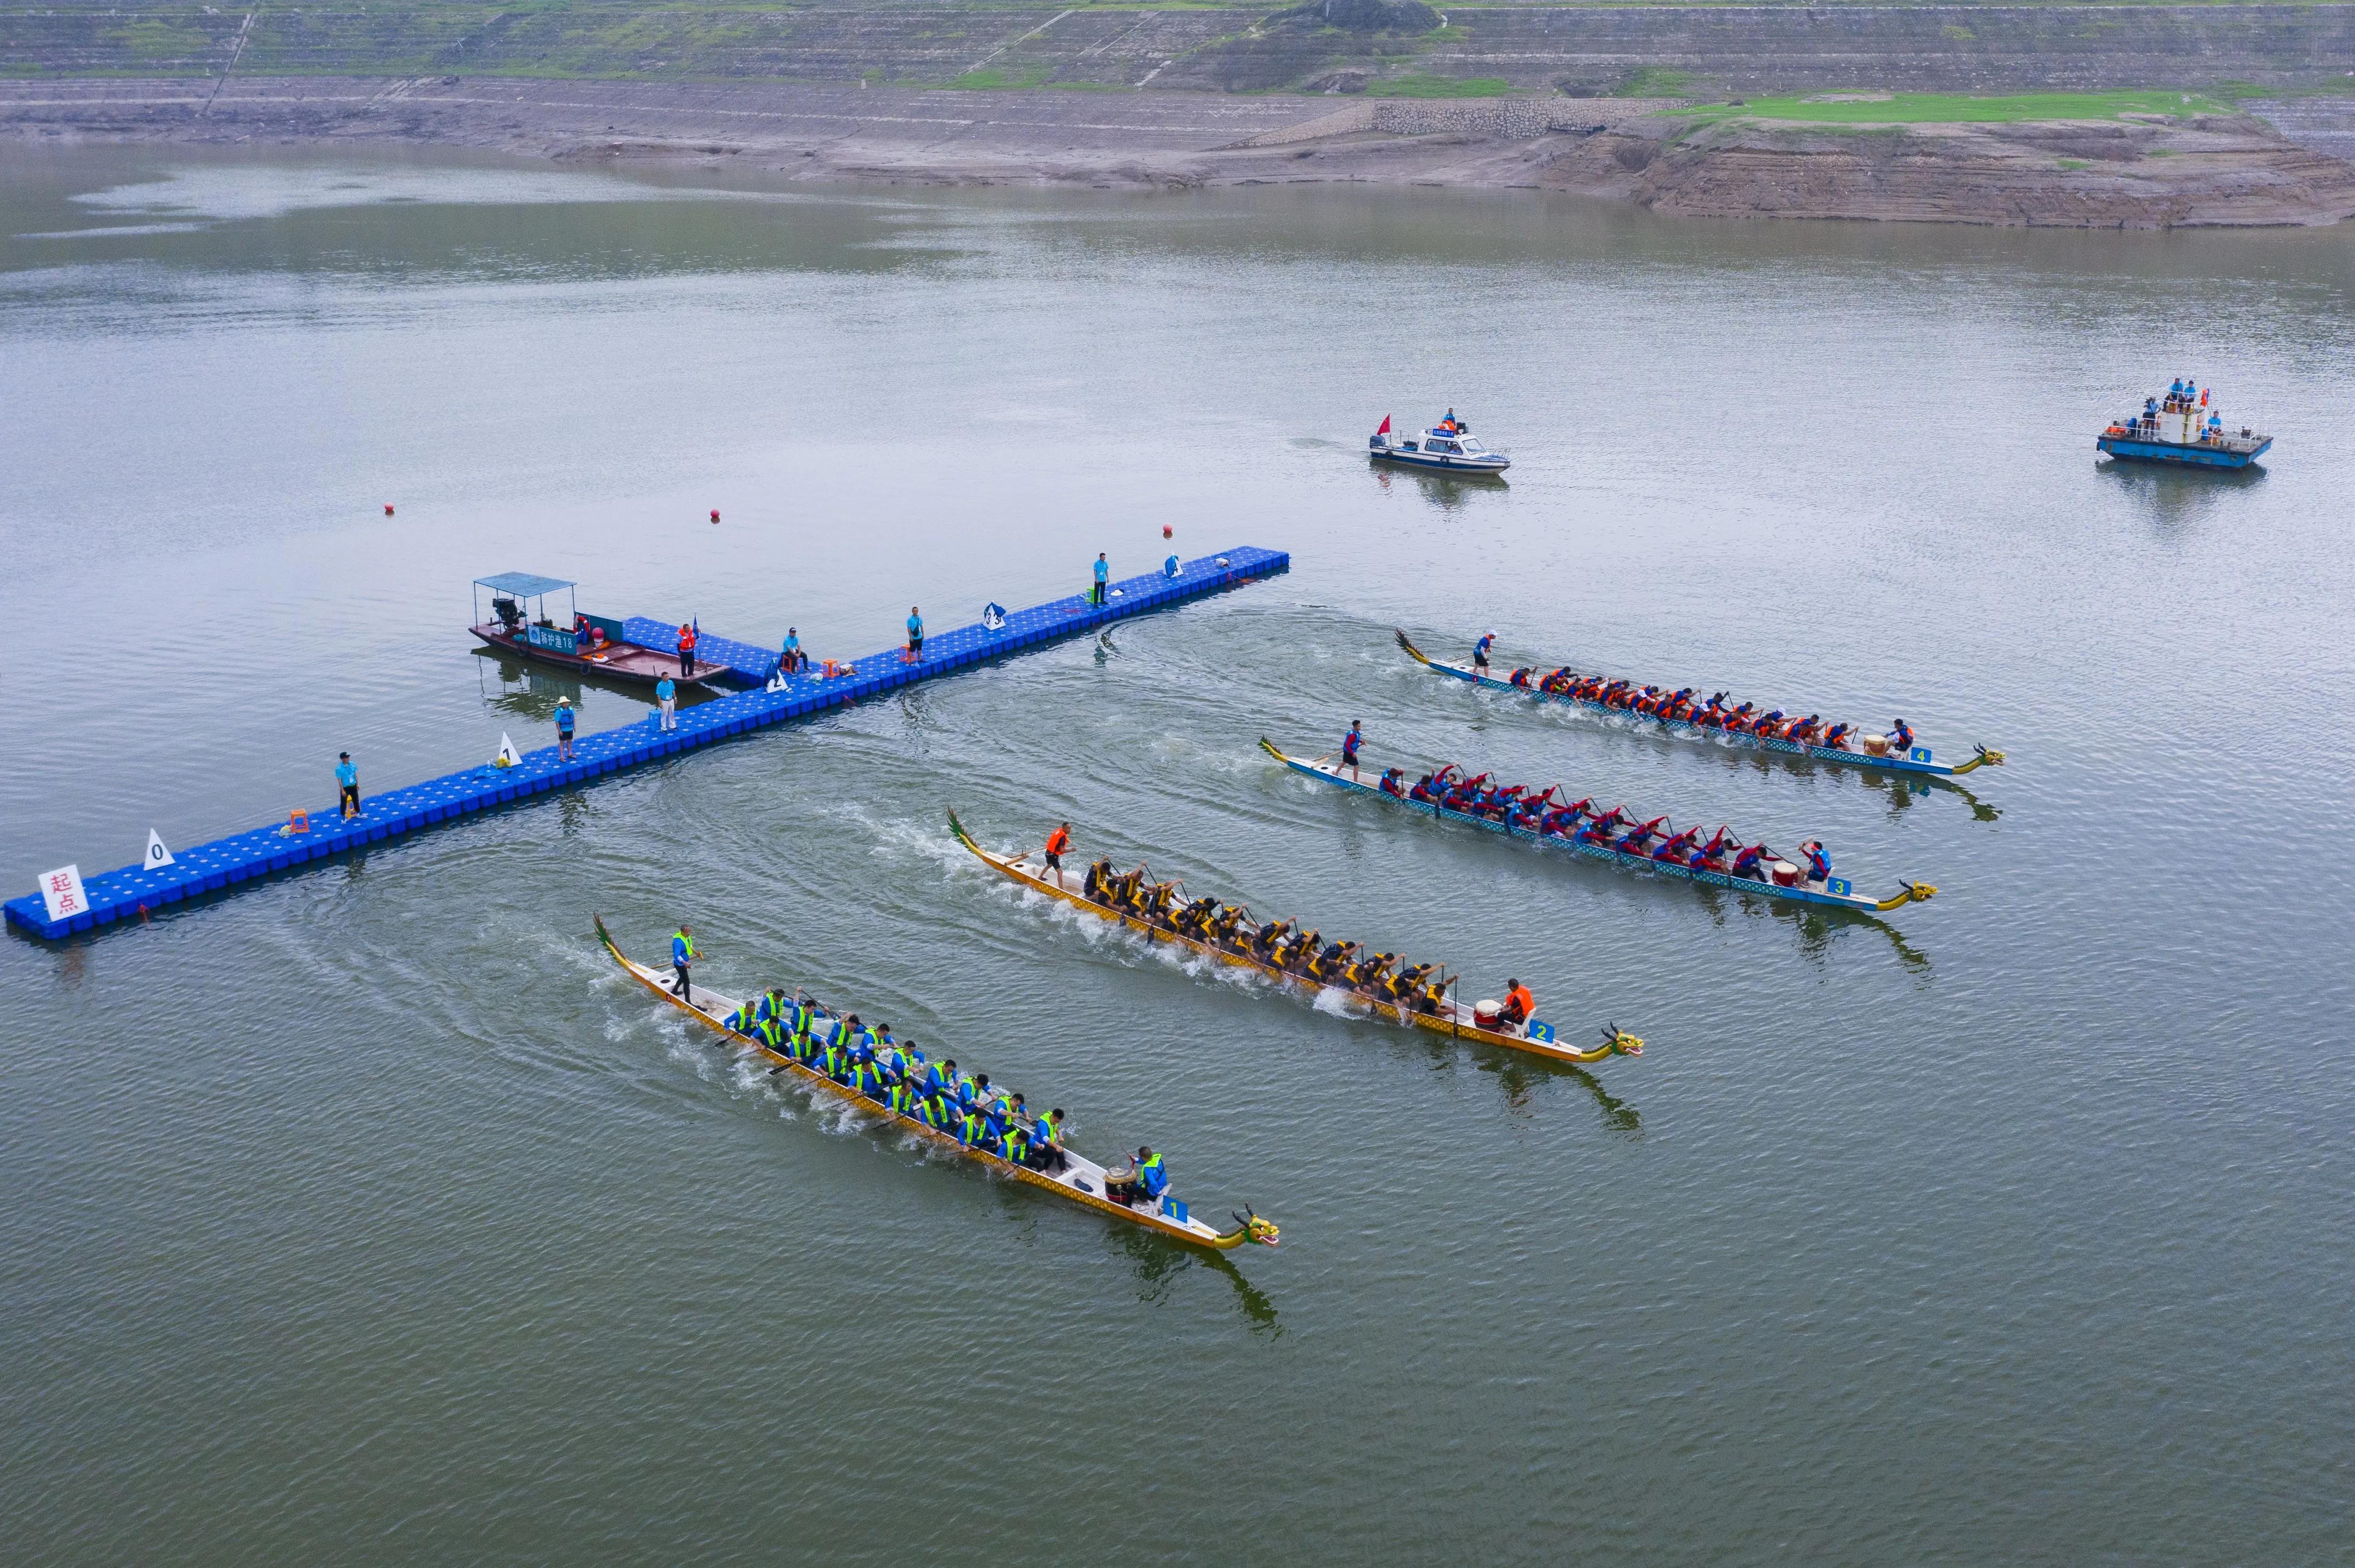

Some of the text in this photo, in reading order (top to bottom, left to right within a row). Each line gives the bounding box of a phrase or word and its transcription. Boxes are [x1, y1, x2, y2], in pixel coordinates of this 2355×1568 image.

[987, 613, 991, 625] 3
[994, 613, 999, 625] 3
[503, 748, 510, 761] 1
[1917, 750, 1924, 761] 4
[152, 844, 163, 860] 0
[50, 873, 79, 914] 起点
[1835, 881, 1843, 894] 3
[1537, 1025, 1546, 1041] 2
[1170, 1202, 1177, 1218] 1
